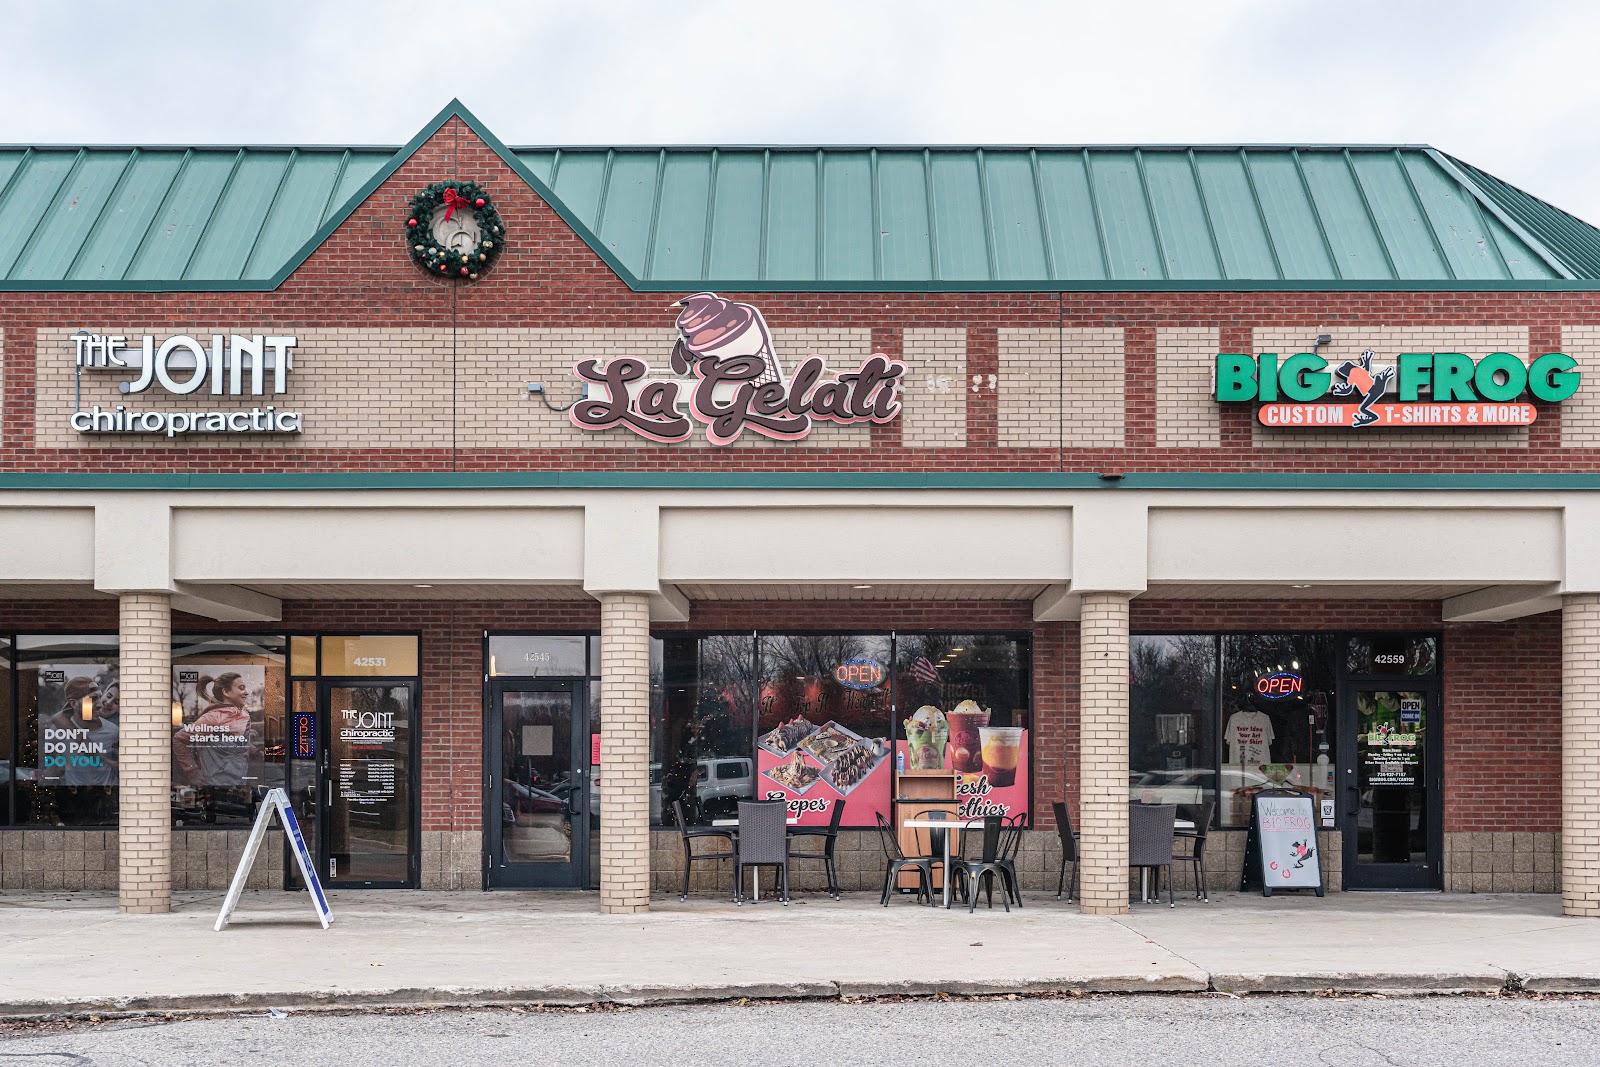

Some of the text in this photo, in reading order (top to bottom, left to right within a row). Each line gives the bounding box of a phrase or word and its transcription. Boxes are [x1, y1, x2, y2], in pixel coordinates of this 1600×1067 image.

[70, 334, 298, 396] THE JOINT
[1216, 353, 1582, 402] BIG FROG
[571, 353, 908, 445] La Gelati
[1267, 405, 1531, 424] CUSTOM T-SHIRTS & MORE
[70, 405, 301, 438] chiropractic
[353, 657, 387, 667] 42531
[523, 652, 550, 662] 42545
[1374, 654, 1405, 664] 42559
[836, 665, 881, 682] OPEN
[1257, 678, 1302, 693] OPEN
[1402, 701, 1420, 710] OPEN
[341, 709, 394, 729] THE JOINT
[44, 728, 90, 740] DON'T
[183, 723, 230, 733] Wellness
[340, 729, 394, 738] chiropractic
[189, 733, 248, 743] starts here.
[299, 717, 309, 754] OPEN
[1367, 733, 1416, 741] BIG FROG
[44, 742, 107, 754] DO PAIN.
[44, 755, 104, 767] DO YOU.
[1262, 817, 1282, 829] BIG
[1284, 816, 1311, 830] FROG
